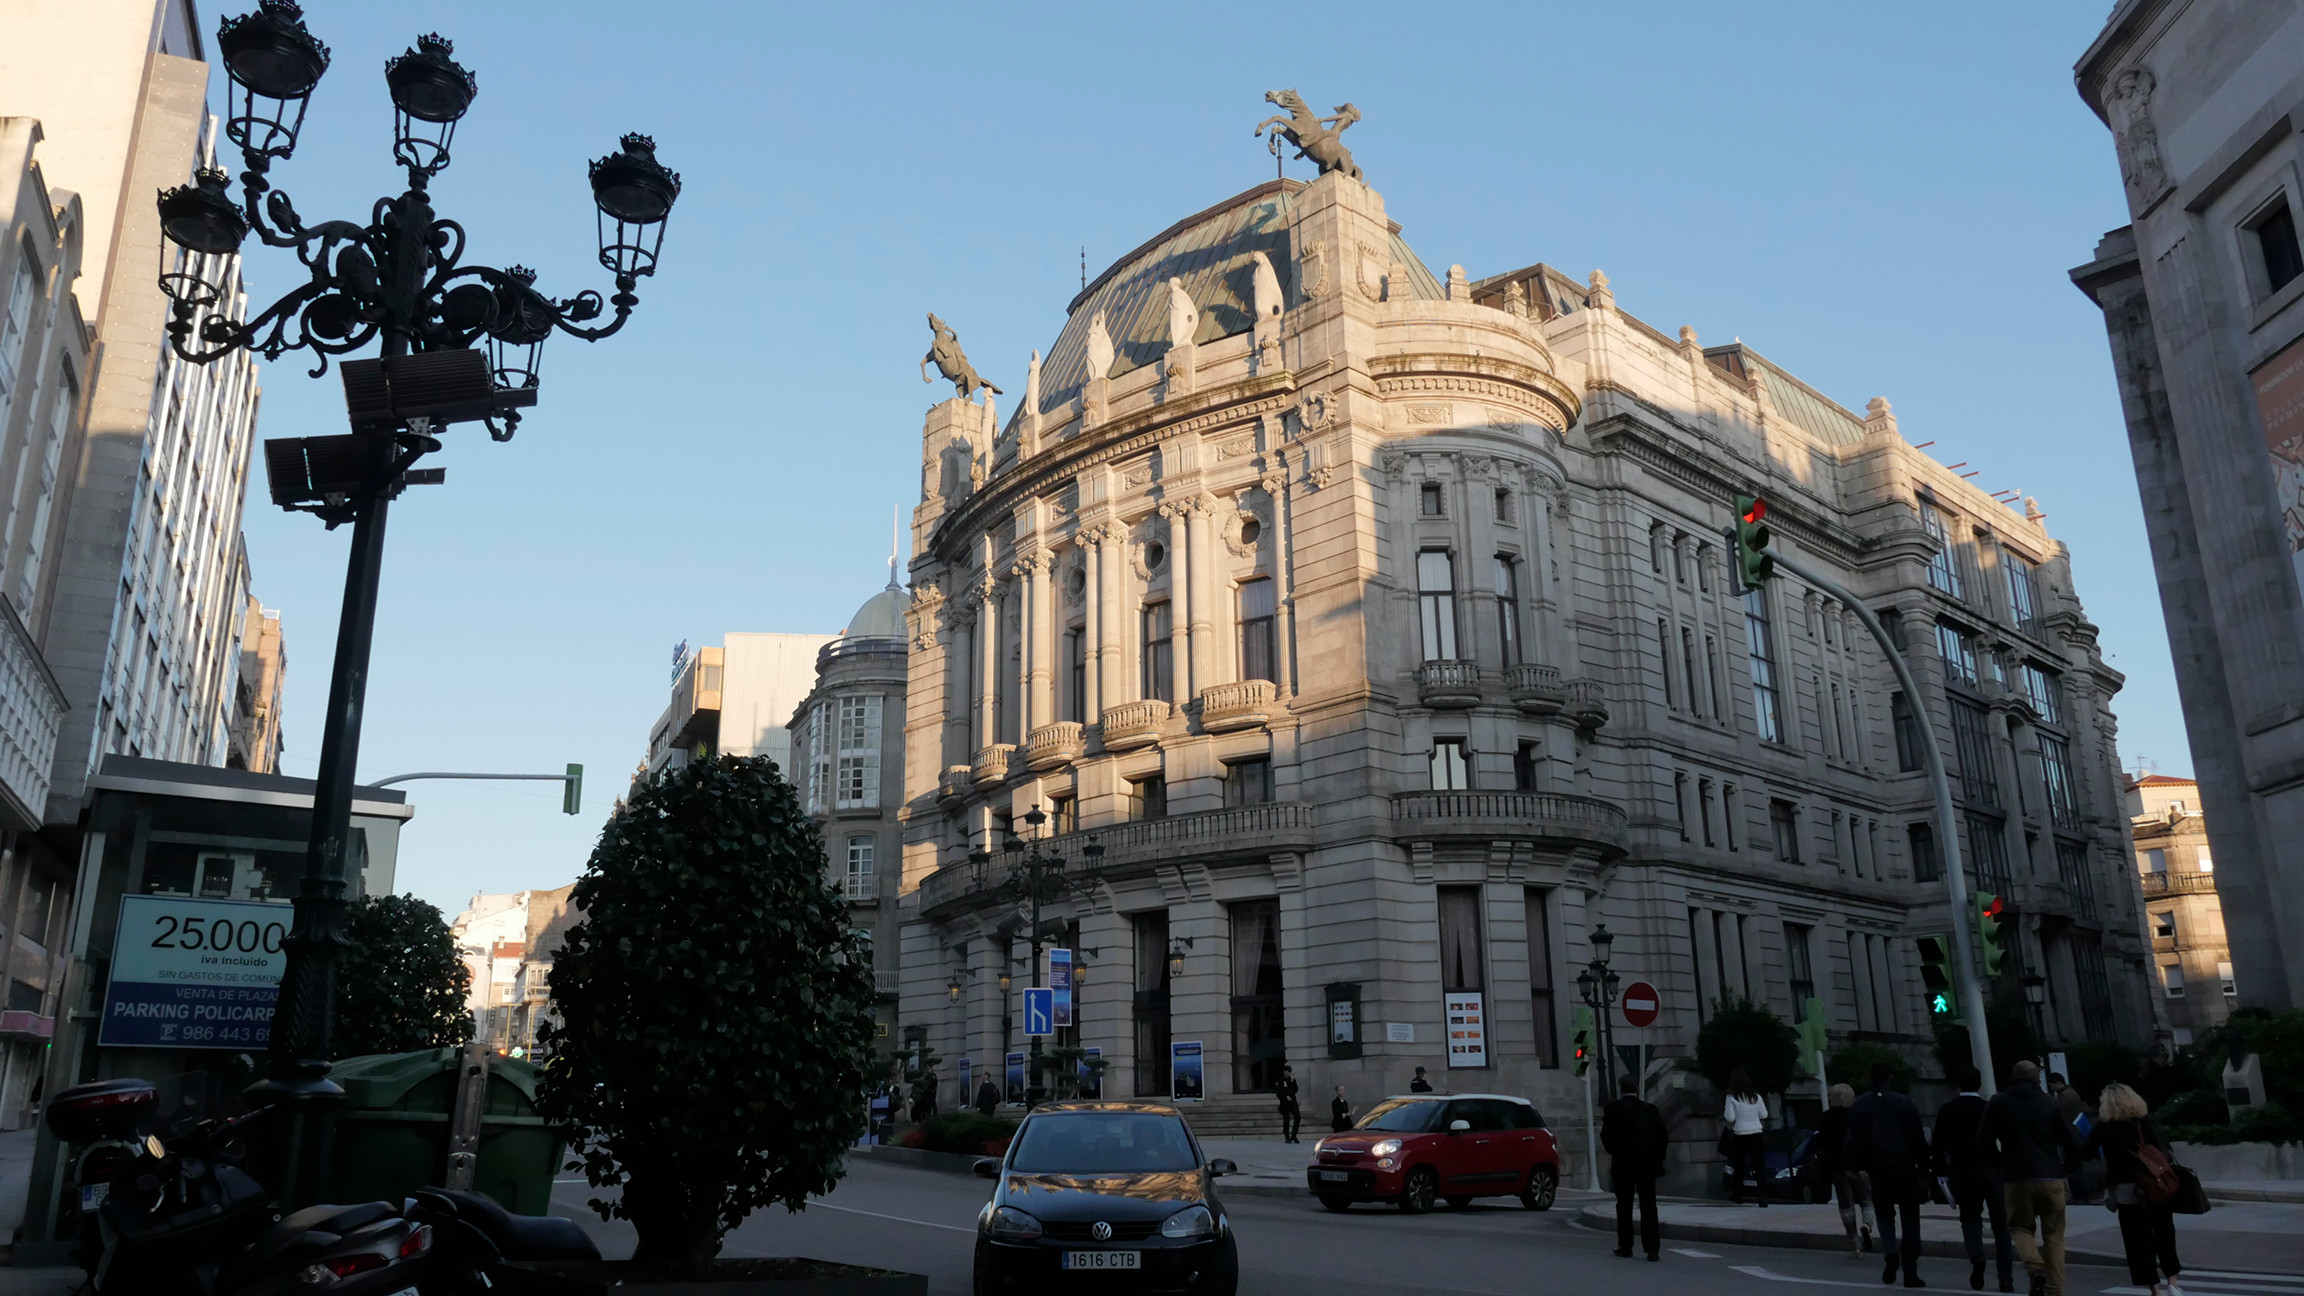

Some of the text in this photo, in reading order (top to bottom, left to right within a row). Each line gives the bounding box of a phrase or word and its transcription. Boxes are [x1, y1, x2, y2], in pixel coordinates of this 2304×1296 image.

[151, 915, 286, 955] 25.000
[201, 955, 268, 967] iva incluido
[158, 970, 176, 979] SIN
[178, 971, 222, 981] GASTOS
[225, 973, 239, 982] DE
[176, 988, 216, 1000] VENTA
[219, 989, 235, 1000] DE
[114, 1002, 190, 1019] PARKING
[182, 1026, 214, 1041] 986
[219, 1027, 250, 1042] 443
[1072, 1253, 1135, 1267] 1616 CTB
